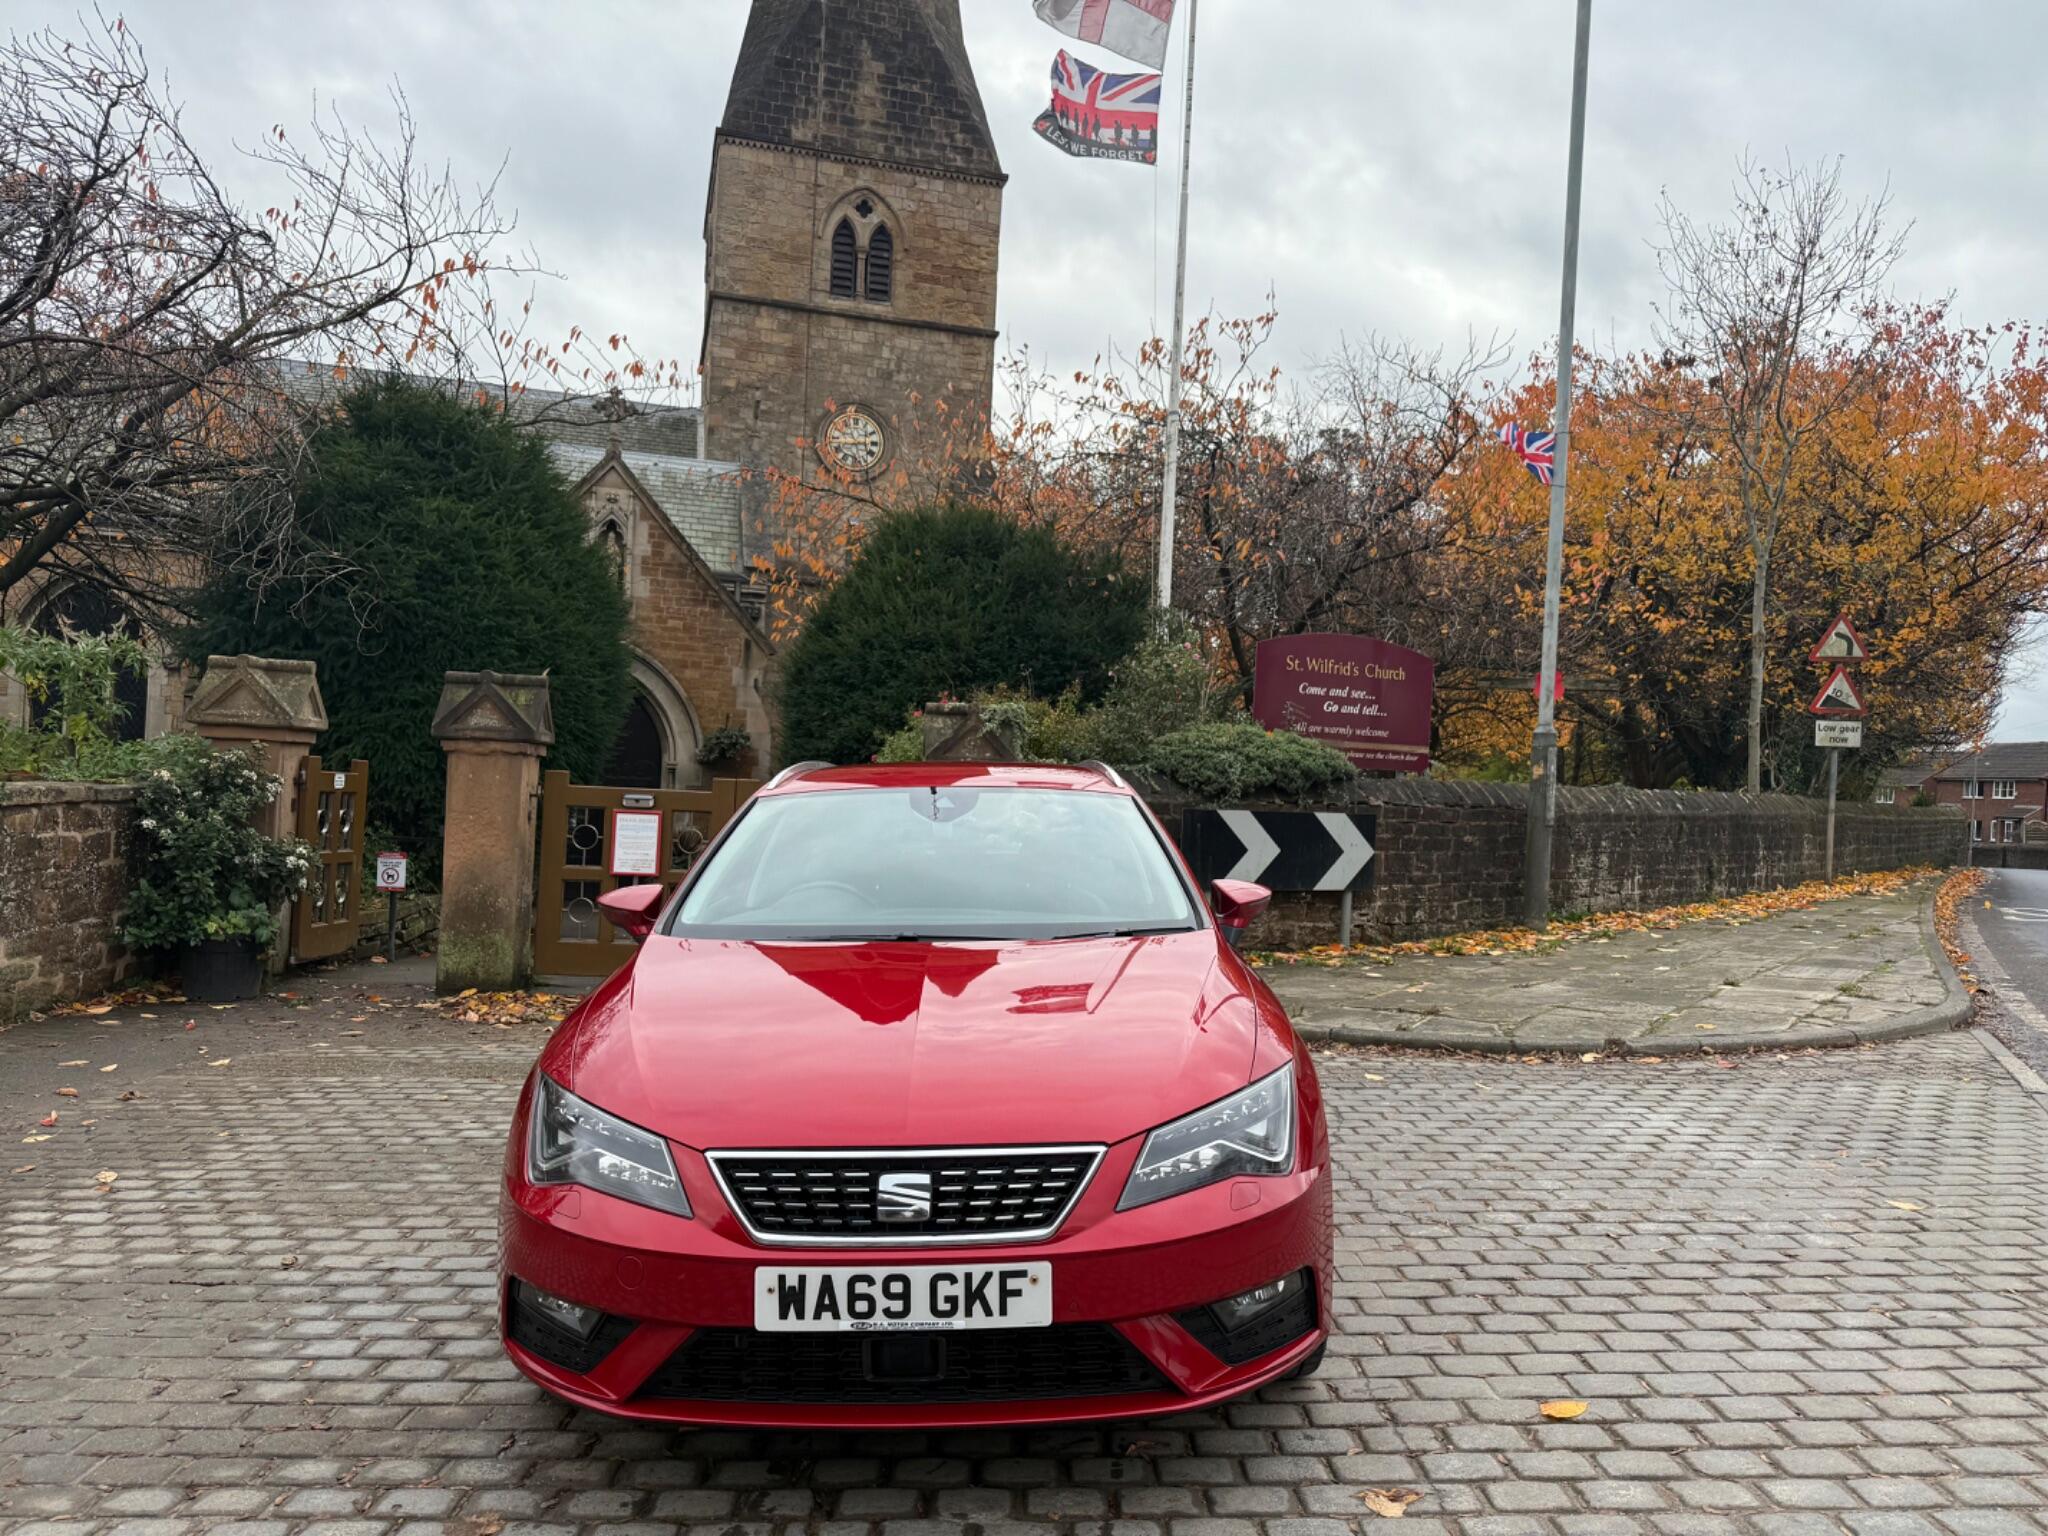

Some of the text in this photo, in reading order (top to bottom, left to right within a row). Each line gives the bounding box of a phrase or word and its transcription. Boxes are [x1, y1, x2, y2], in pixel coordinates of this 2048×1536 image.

[1070, 140, 1088, 156] WE
[1091, 147, 1144, 160] FORGET
[1286, 655, 1405, 681] St. Wilfrid's Church
[1299, 682, 1376, 700] Come and see...
[1323, 701, 1339, 713] Go
[1341, 703, 1360, 714] and
[1308, 725, 1322, 733] are
[1324, 725, 1352, 737] warmly
[1355, 727, 1389, 737] welcome
[1818, 723, 1860, 735] Low gear
[1829, 736, 1849, 744] now
[777, 1269, 1029, 1321] WA69 GKF
